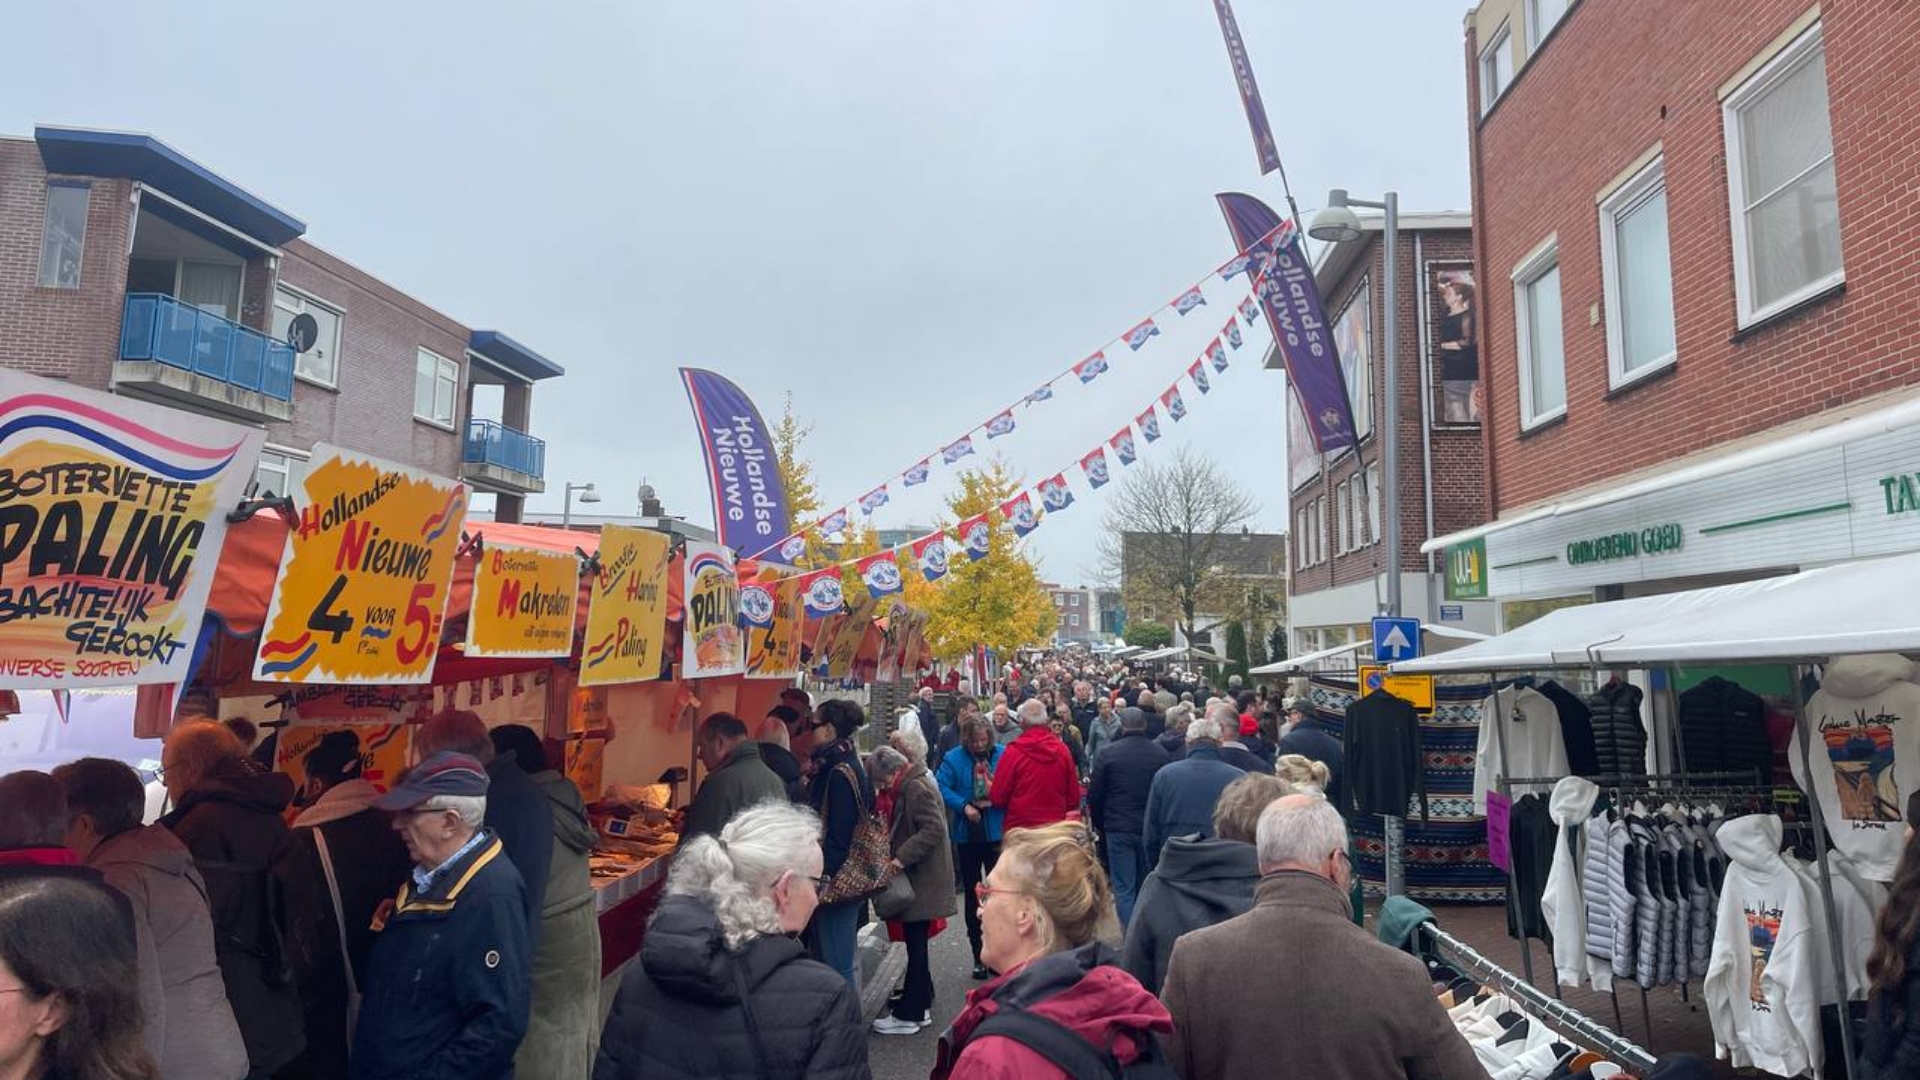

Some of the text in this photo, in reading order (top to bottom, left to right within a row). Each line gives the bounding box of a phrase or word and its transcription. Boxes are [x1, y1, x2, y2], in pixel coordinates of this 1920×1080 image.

[1278, 250, 1324, 357] ollandse
[299, 471, 402, 541] Hollandse
[713, 427, 744, 521] Nieuwe
[732, 415, 776, 535] Hollandse
[0, 500, 206, 601] PALING
[335, 519, 432, 581] Nieuwe
[1641, 523, 1682, 554] GOED
[307, 574, 354, 644] 4
[497, 578, 570, 620] Makrelen
[0, 659, 140, 678] IVERSE SOORTEN
[65, 621, 186, 665] GEROOKT
[615, 617, 648, 667] Paling
